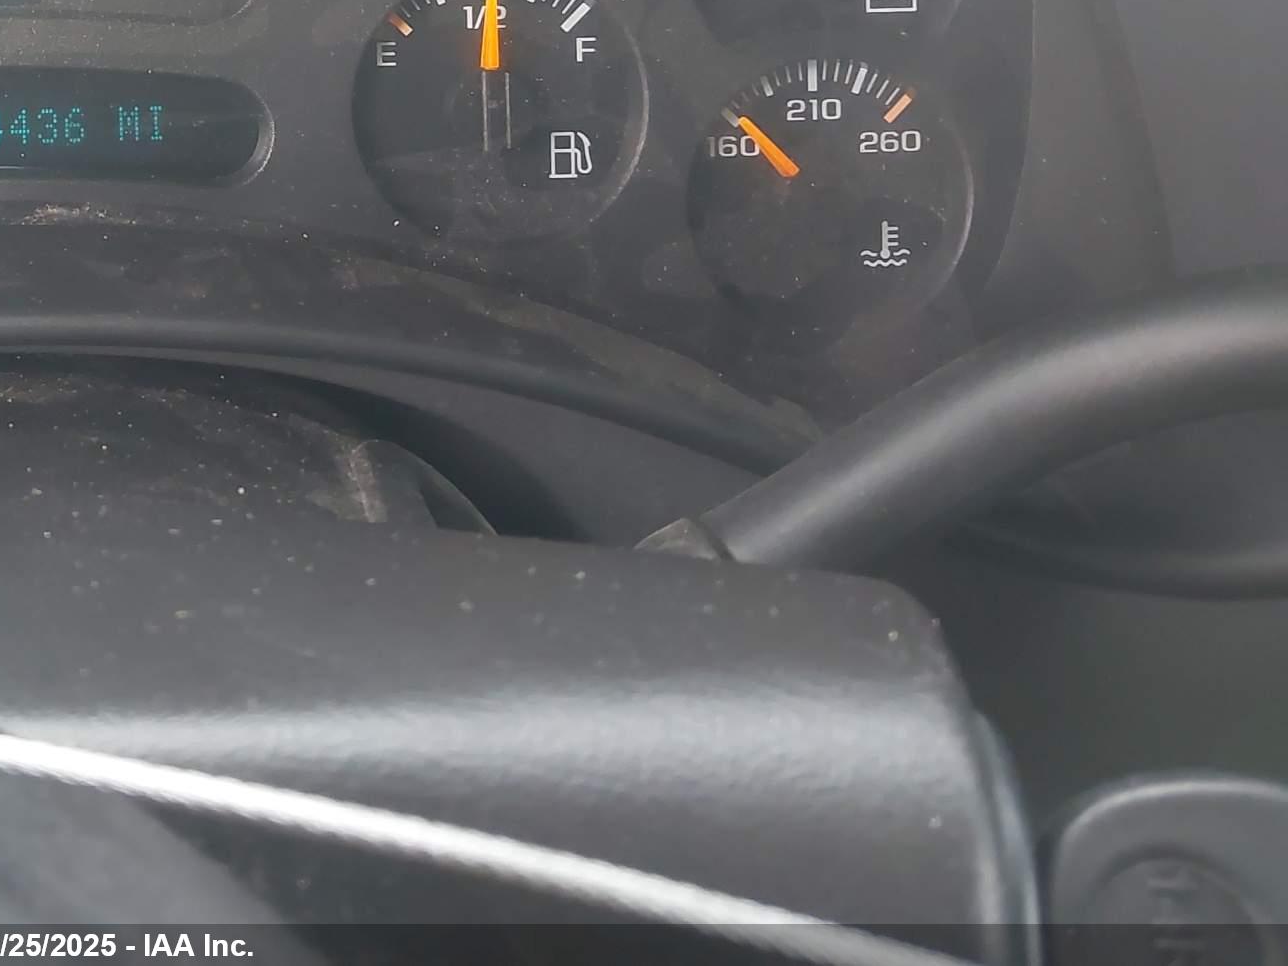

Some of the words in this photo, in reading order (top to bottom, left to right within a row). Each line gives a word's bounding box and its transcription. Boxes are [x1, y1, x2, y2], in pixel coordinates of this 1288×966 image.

[377, 41, 397, 67] E
[575, 37, 597, 62] F
[786, 98, 842, 121] 210
[118, 105, 164, 141] MI
[706, 135, 760, 157] 160
[859, 131, 921, 153] 260
